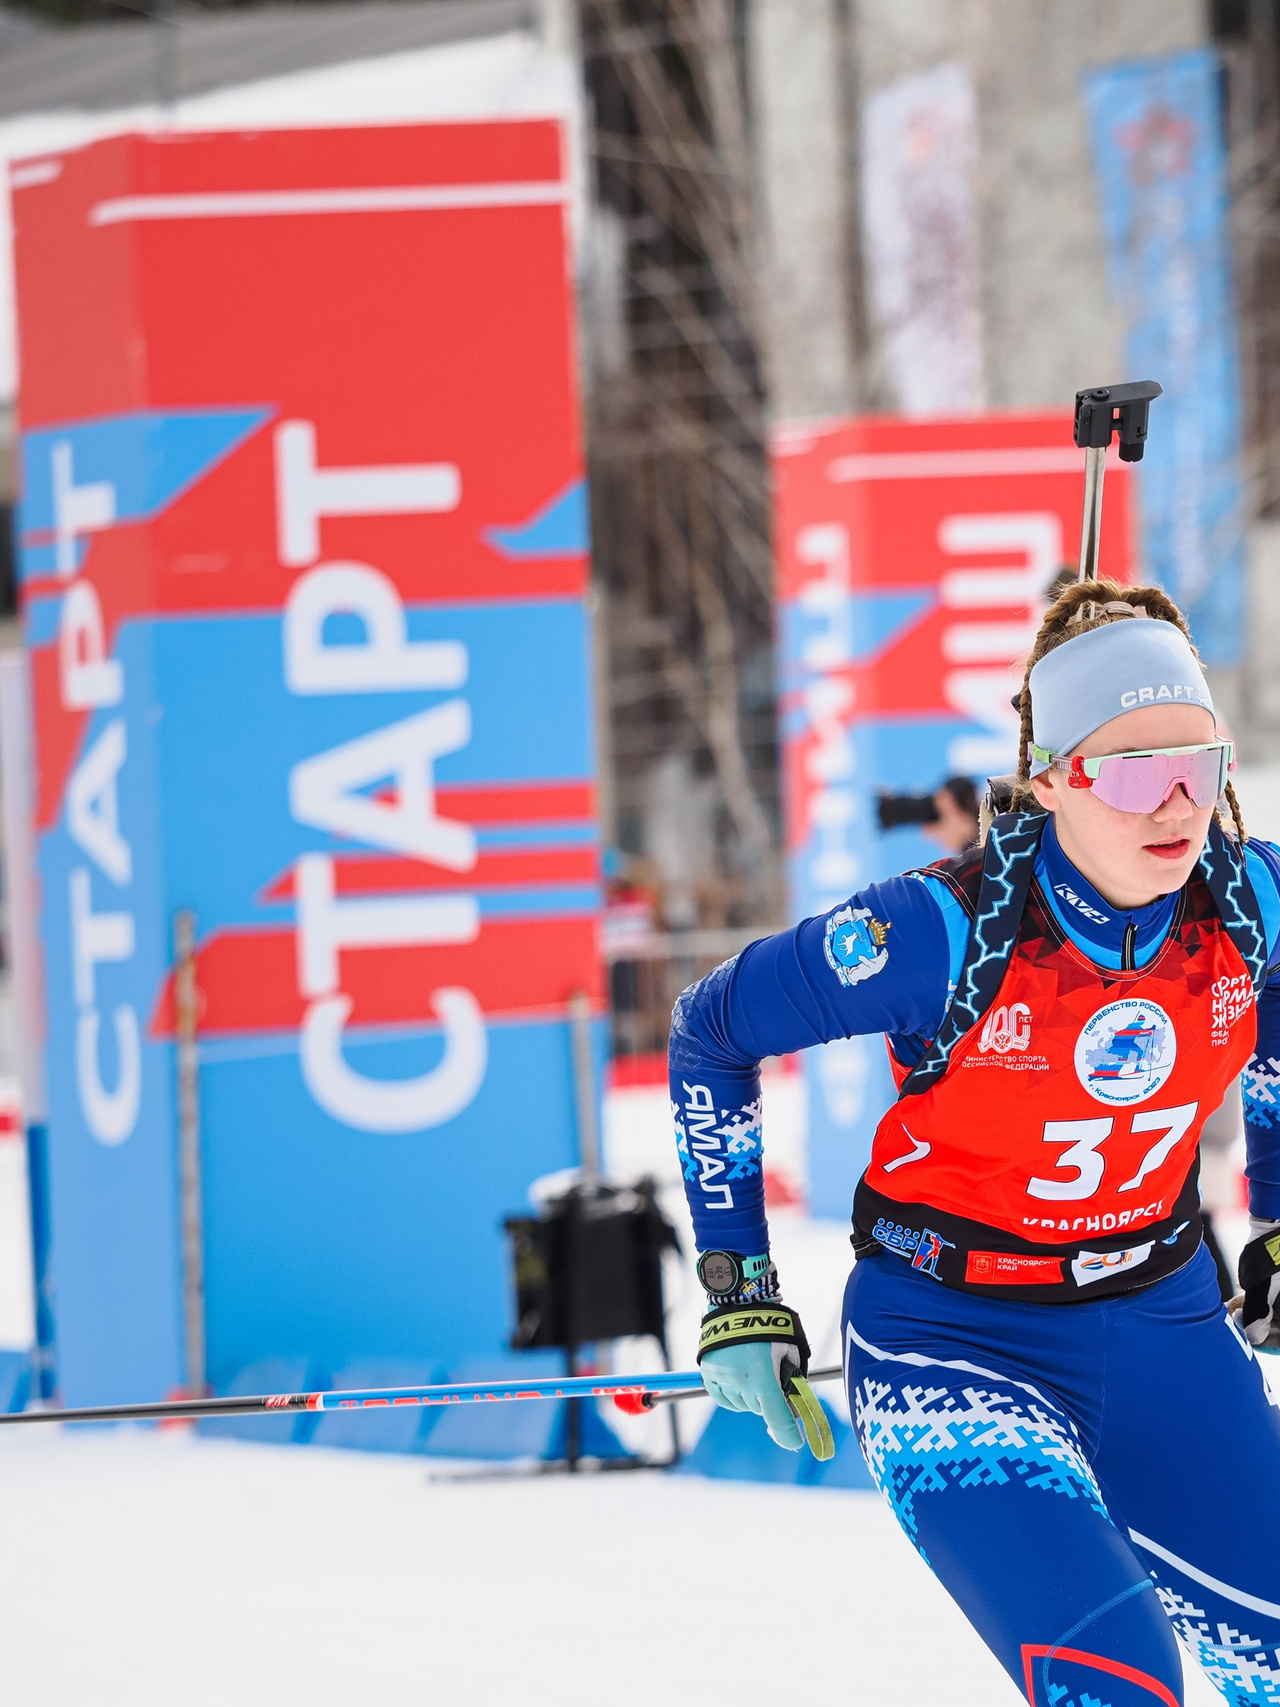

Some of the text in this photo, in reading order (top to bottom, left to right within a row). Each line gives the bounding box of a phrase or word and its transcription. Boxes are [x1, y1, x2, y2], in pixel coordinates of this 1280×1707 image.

[1120, 684, 1194, 709] CRAFT
[274, 418, 488, 1134] СТАРТ
[52, 440, 142, 1146] СТАРТ
[1018, 1016, 1034, 1024] ЛЕТ
[1084, 1001, 1168, 1036] ПЕРВЕНСТВО РОССИИ
[1004, 1063, 1050, 1072] ФЕДЕРАЦИИ
[1018, 1055, 1047, 1063] СПОРТА
[1094, 1087, 1141, 1103] Красноярск
[682, 1079, 735, 1210] ЯМАЛ
[1025, 1099, 1200, 1201] 37
[872, 1224, 920, 1251] СБР
[997, 1264, 1018, 1272] КРАЙ
